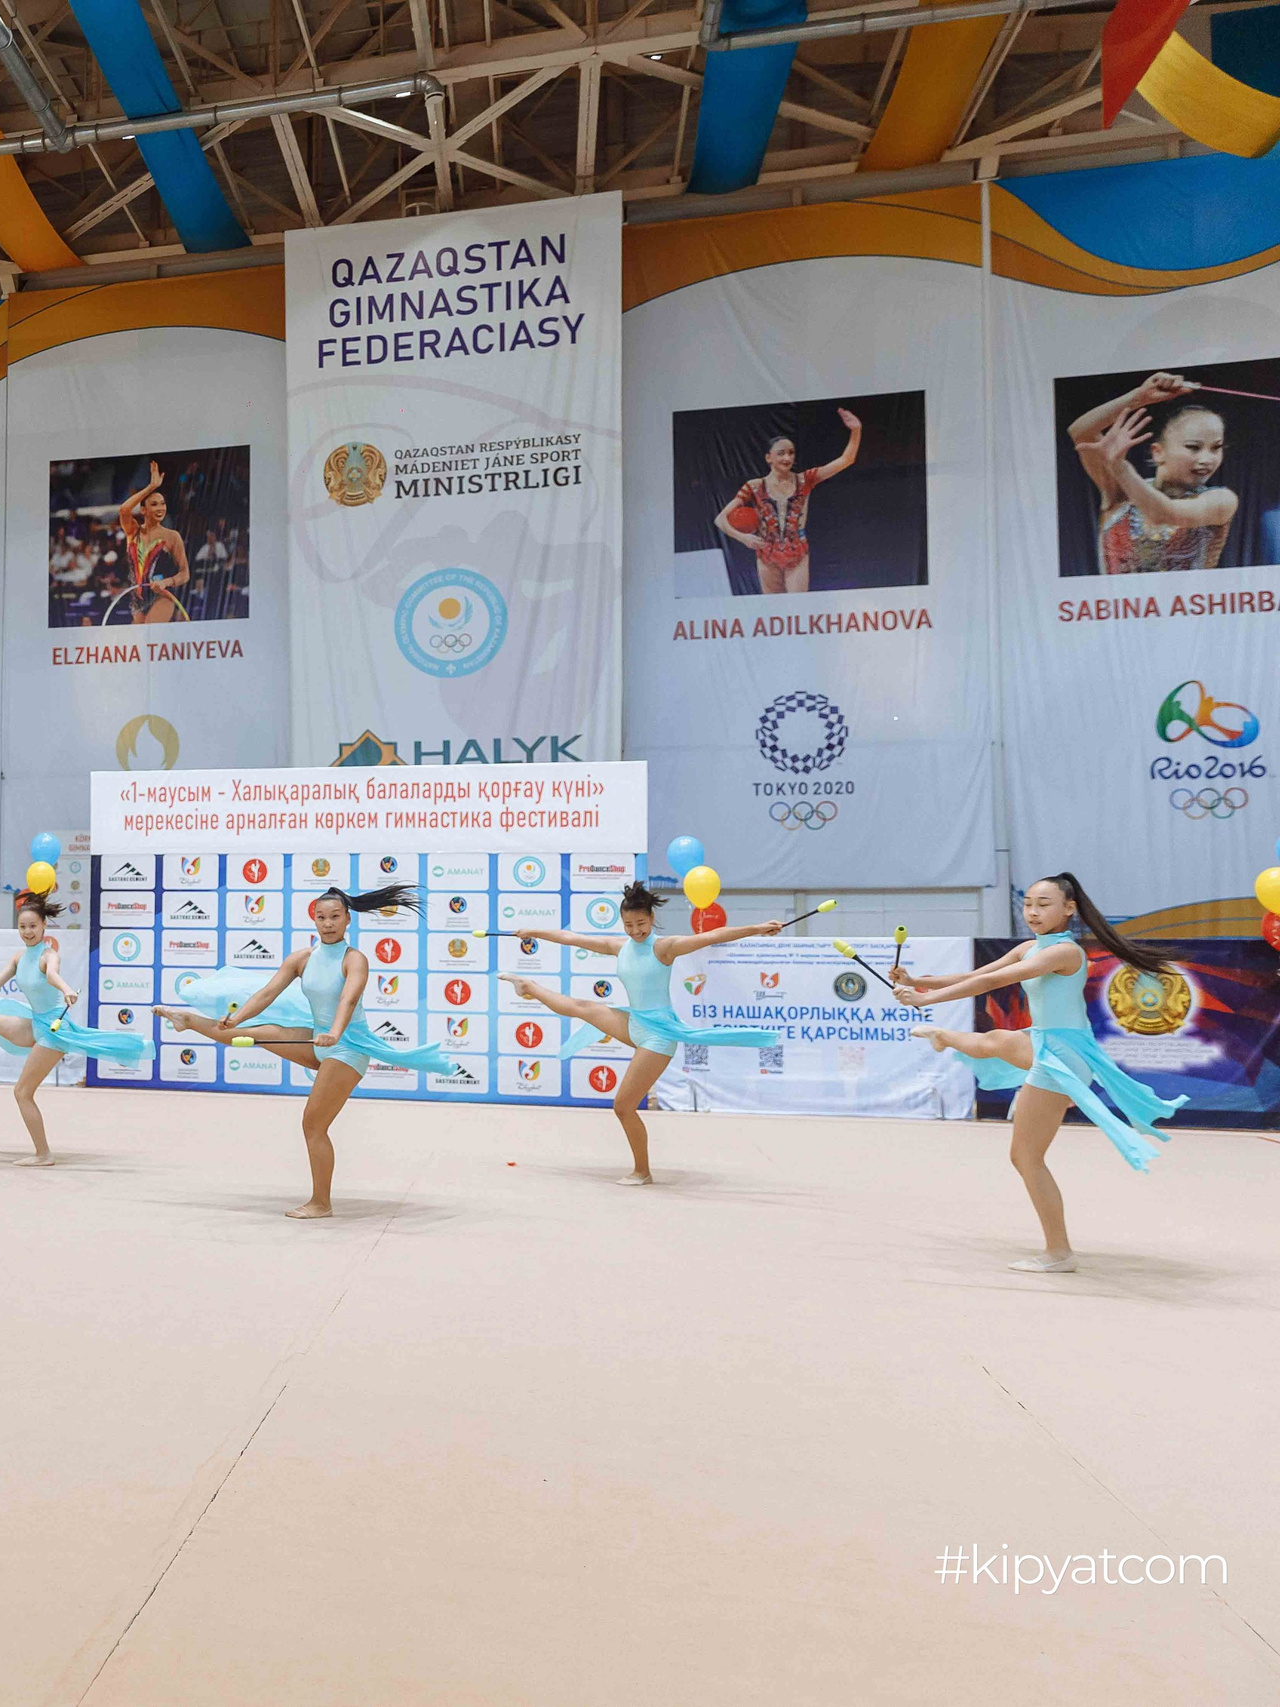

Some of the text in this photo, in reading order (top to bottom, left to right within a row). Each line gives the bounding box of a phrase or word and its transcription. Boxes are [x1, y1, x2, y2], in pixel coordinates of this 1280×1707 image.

[331, 233, 566, 288] QAZAQSTAN
[329, 275, 571, 328] GIMNASTIKA
[318, 313, 585, 369] FEDERACIASY
[394, 444, 475, 460] QAZAQSTAN
[394, 448, 582, 476] MÁDENIET JÁNE SPORT
[394, 465, 582, 499] MINISTRLIGI
[673, 608, 933, 641] ALINA ADILKHANOVA
[1057, 596, 1161, 623] SABINA
[52, 639, 244, 666] ELZHANA TANIYEVA
[414, 734, 583, 765] HALYK
[231, 779, 360, 806] Халықаралық
[366, 777, 470, 805] балаларды
[478, 779, 545, 805] қорғау
[752, 781, 855, 796] TOKYO 2020
[124, 804, 599, 836] мерекесіне арналған көркем гимнастика фестивалі
[692, 1004, 718, 1018] БІЗ
[723, 1005, 875, 1024] НАШАҚОРЛЫҚҚА
